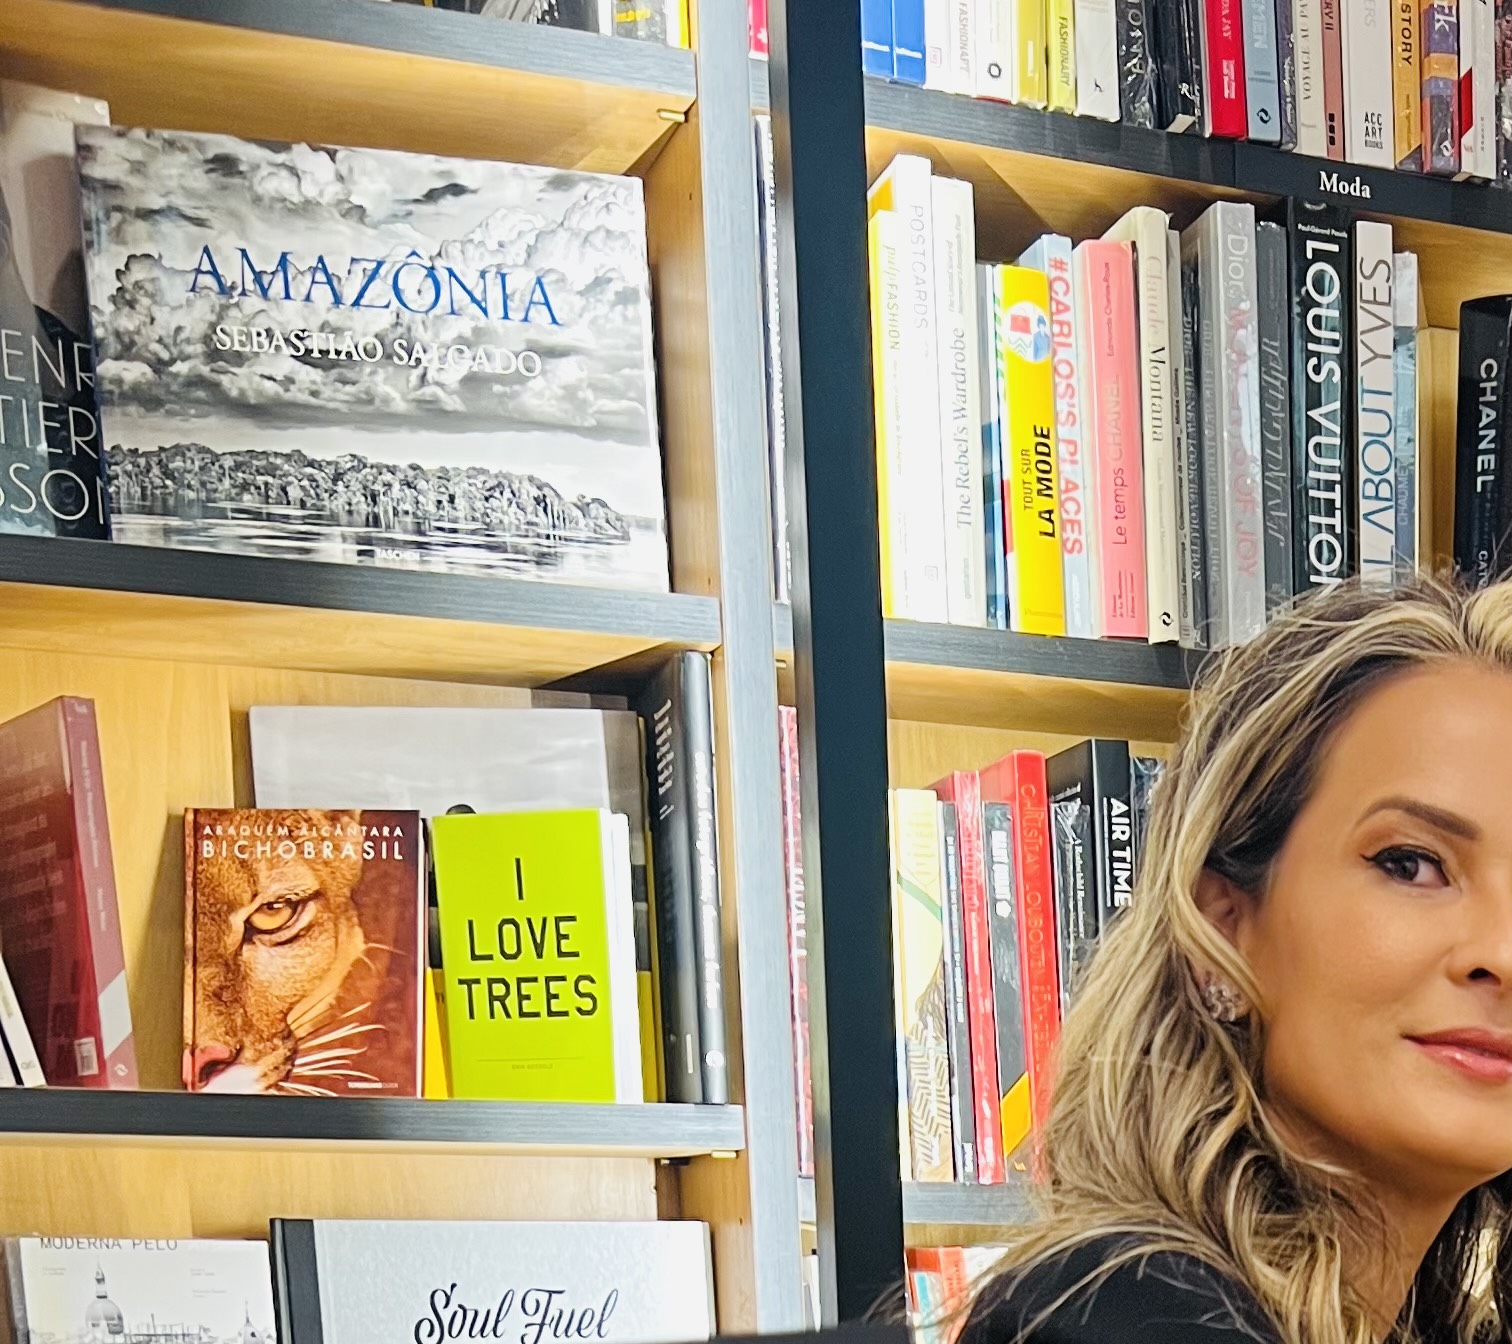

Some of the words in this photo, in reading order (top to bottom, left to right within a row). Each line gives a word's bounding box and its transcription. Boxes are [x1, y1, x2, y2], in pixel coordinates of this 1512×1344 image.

[1058, 15, 1071, 88] FASHIONARY
[1364, 112, 1383, 127] ACC
[1364, 126, 1383, 141] ART
[1319, 170, 1372, 200] Moda
[186, 244, 564, 326] AMAZÔNIA
[909, 204, 928, 329] POSTCARDS
[1227, 234, 1248, 286] Dior
[886, 284, 900, 351] FASHION
[1145, 255, 1164, 336] Claude
[1305, 239, 1342, 384] LOUIS
[1359, 256, 1392, 368] YVES
[214, 324, 384, 363] SEBASTIÃO
[393, 338, 543, 377] SALGADO
[1048, 257, 1077, 428] #CARLOS'S
[949, 327, 968, 421] Wardrobe
[1147, 343, 1166, 443] Montana
[1104, 374, 1124, 462] CHANEL
[1476, 358, 1499, 493] CHANEL
[952, 426, 971, 490] Rebel's
[1020, 449, 1033, 475] SUR
[1032, 425, 1054, 500] MODE
[1360, 375, 1393, 535] ABOUT
[955, 493, 973, 529] The
[1022, 478, 1035, 511] TOUT
[1057, 437, 1083, 557] PLACES
[1112, 467, 1129, 521] temps
[1233, 472, 1254, 516] OF
[1037, 508, 1056, 539] LA
[1111, 525, 1128, 545] Le
[1234, 521, 1257, 578] JOY
[202, 823, 291, 838] ARAQUÉM
[298, 823, 405, 838] ALCÂNTARA
[1020, 783, 1047, 872] CHRISTIAN
[1110, 797, 1132, 841] AIR
[202, 839, 405, 861] BICHOBRASIL
[1112, 846, 1132, 908] TIME
[514, 857, 524, 902] I
[467, 915, 580, 962] LOVE
[1025, 883, 1047, 978] LOUBOUTIN
[457, 974, 598, 1020] TREES
[40, 1237, 121, 1251] MODERNA
